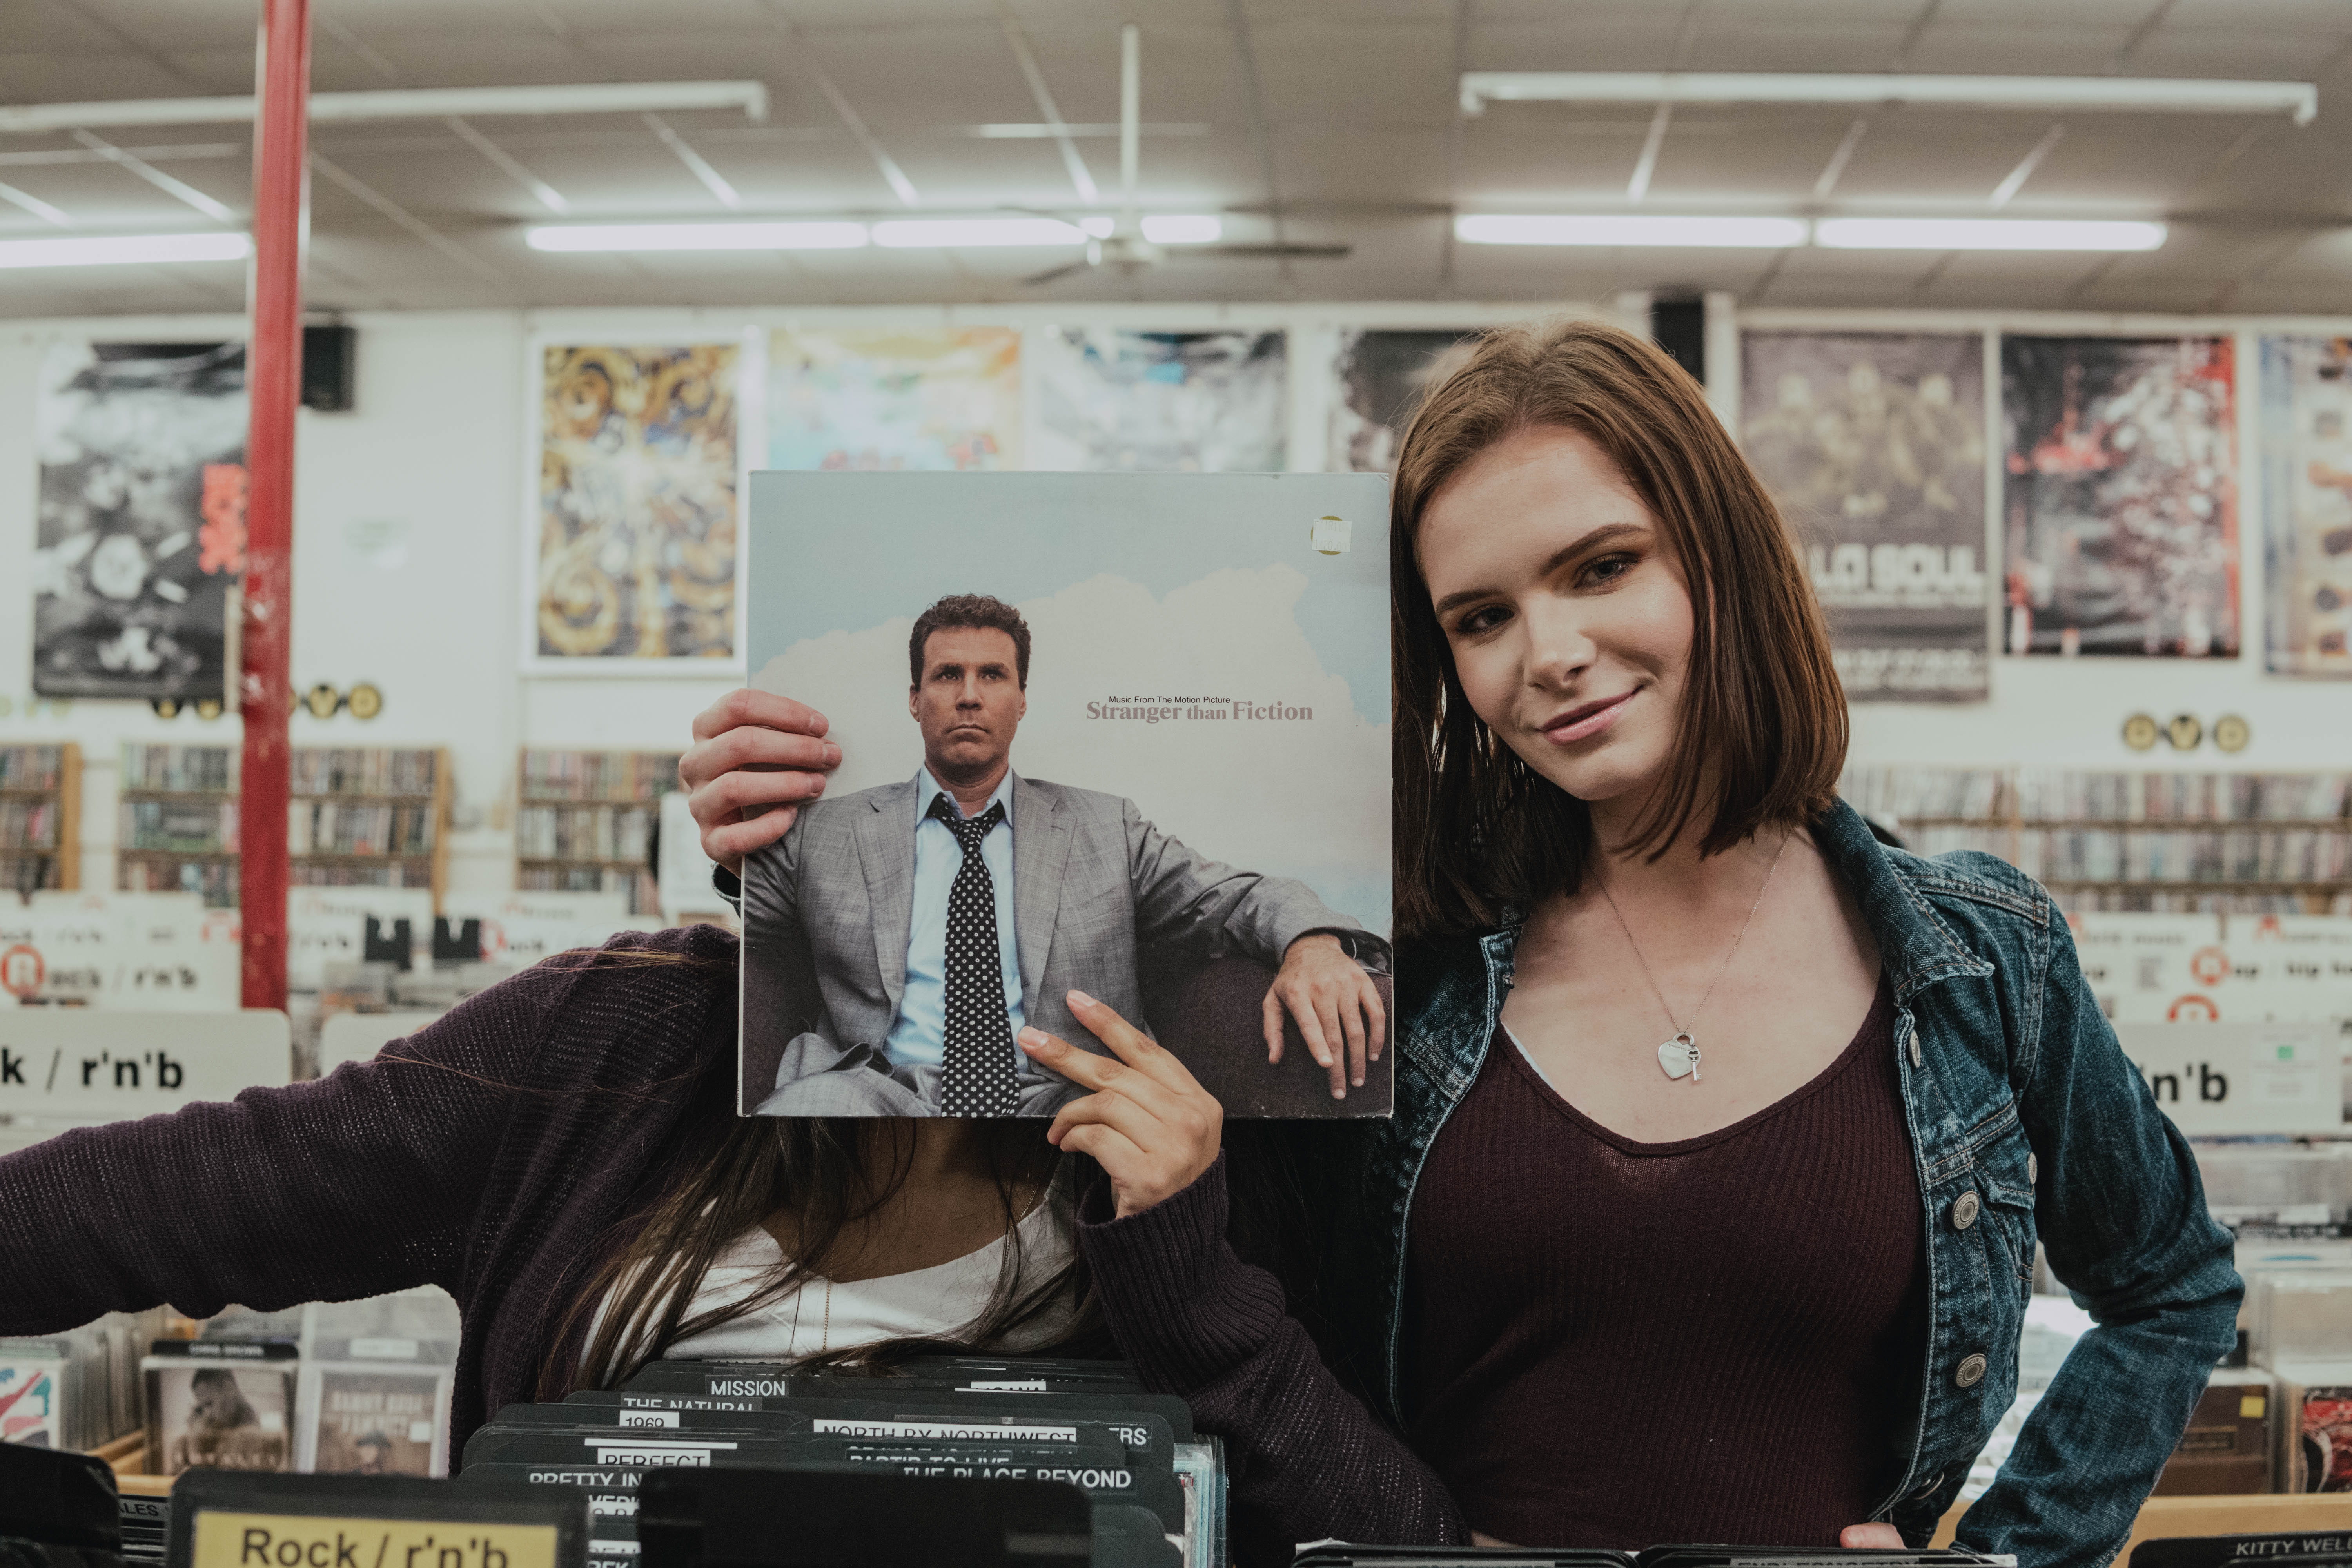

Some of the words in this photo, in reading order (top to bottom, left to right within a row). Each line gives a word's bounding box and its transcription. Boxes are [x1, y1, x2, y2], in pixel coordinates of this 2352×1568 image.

[1087, 701, 1182, 724] Stranger
[1187, 705, 1226, 720] than
[1232, 701, 1313, 720] Fiction
[82, 1050, 184, 1089] r'n'b
[711, 1380, 785, 1396] MISSION
[241, 1528, 358, 1568] Rock
[407, 1534, 509, 1568] r'n'b
[2236, 1540, 2295, 1555] KITTY
